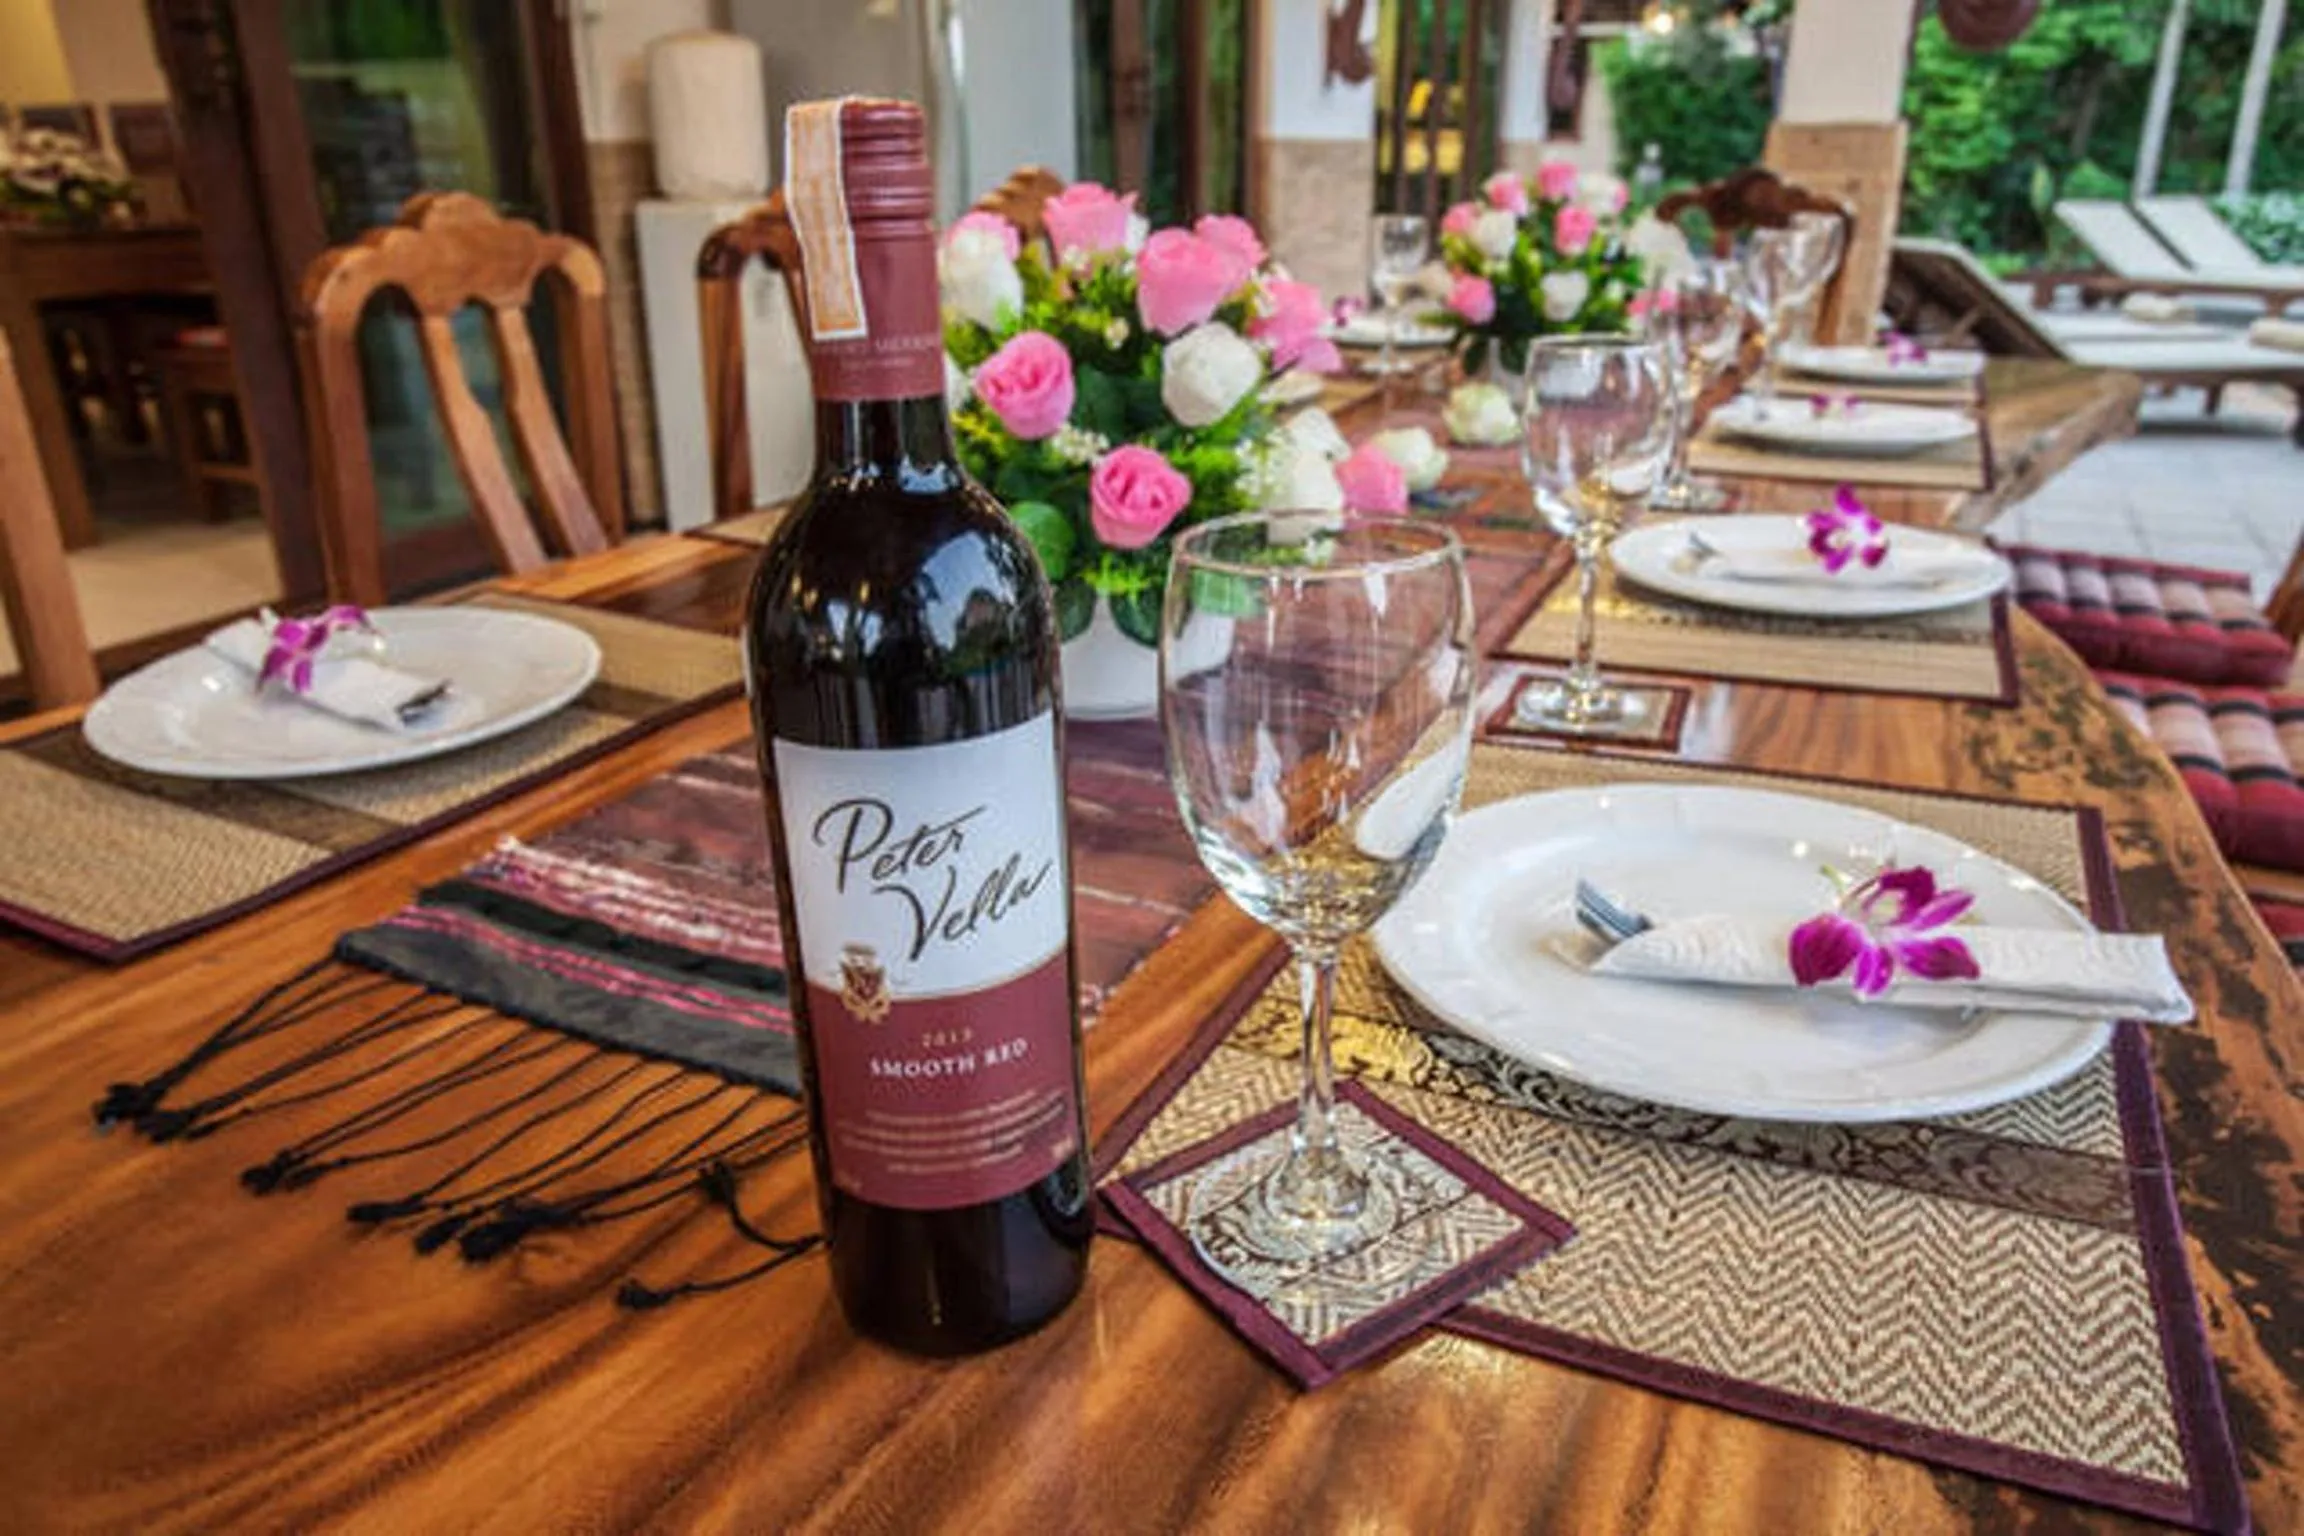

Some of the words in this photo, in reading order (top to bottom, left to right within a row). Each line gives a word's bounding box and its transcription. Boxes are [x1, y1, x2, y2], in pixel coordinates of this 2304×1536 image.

[812, 798, 988, 894] Peter
[871, 852, 1054, 962] Vella
[869, 1054, 976, 1078] SMOOTH
[984, 1037, 1029, 1066] RED
